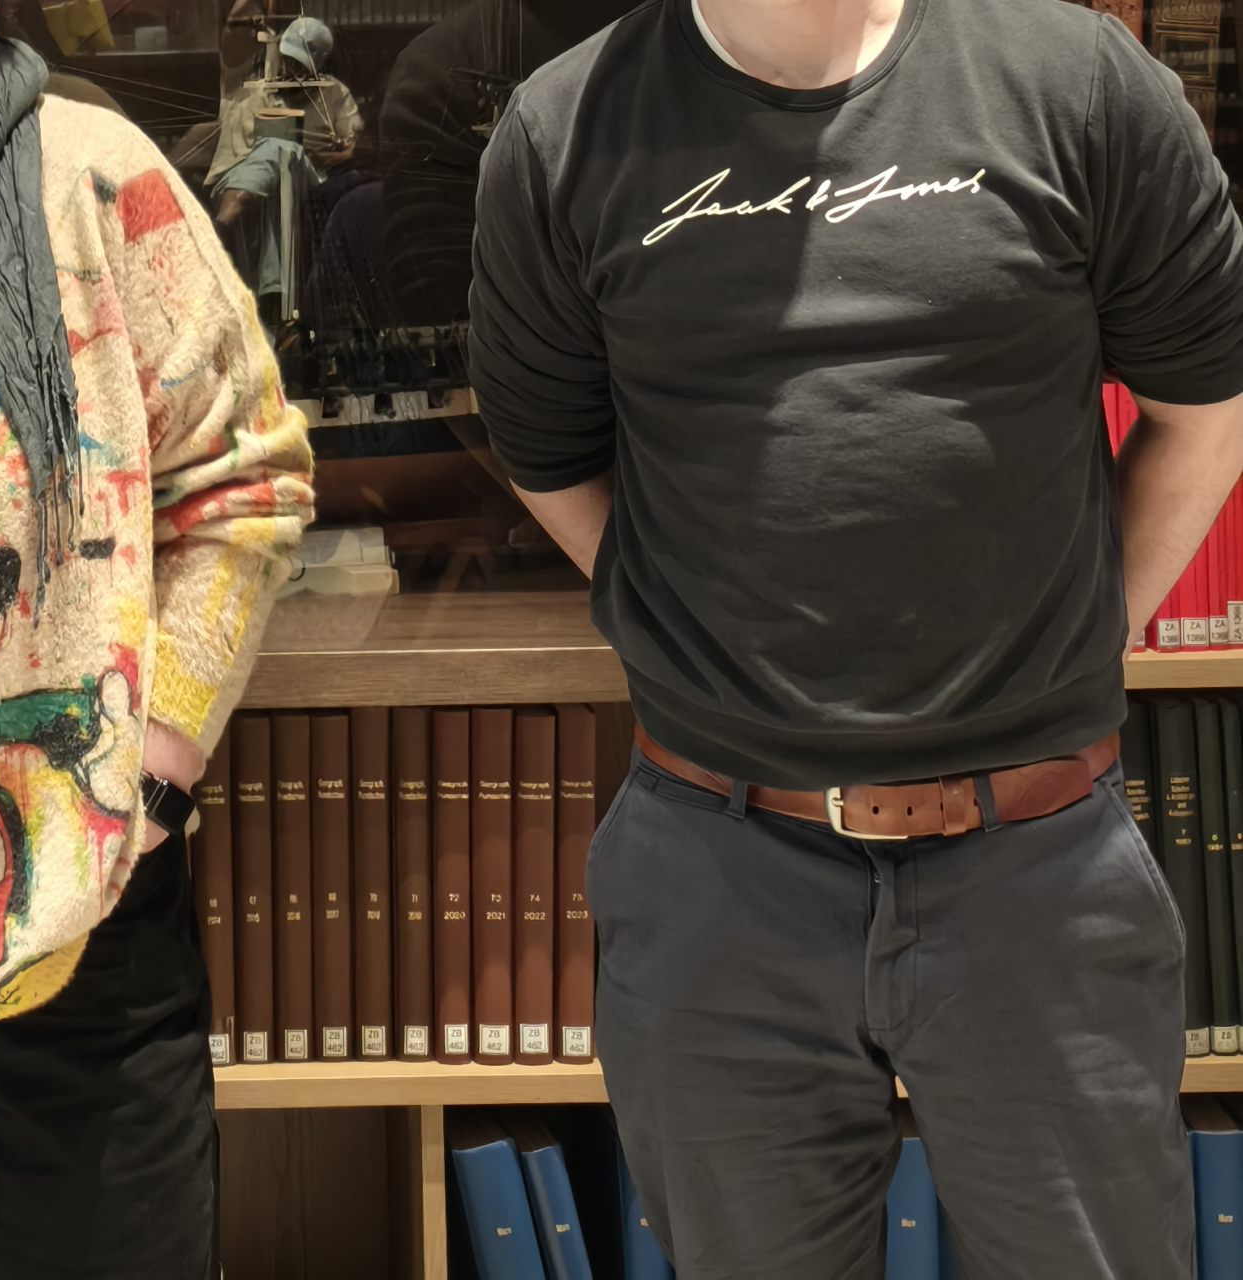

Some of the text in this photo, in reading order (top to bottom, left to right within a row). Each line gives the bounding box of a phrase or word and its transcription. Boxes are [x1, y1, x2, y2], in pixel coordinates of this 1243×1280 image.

[642, 168, 811, 246] Jack
[805, 179, 832, 211] &
[444, 912, 465, 920] 2020
[486, 912, 505, 920] 2021
[524, 912, 545, 920] 2022
[566, 910, 588, 919] 2023
[328, 1032, 340, 1040] ZB
[410, 1030, 422, 1038] ZB
[451, 1029, 462, 1037] ZB
[488, 1030, 500, 1038] ZB
[528, 1028, 540, 1037] ZB
[571, 1031, 582, 1040] ZB
[211, 1039, 222, 1047] ZB
[249, 1036, 261, 1044] ZB
[327, 1044, 342, 1052] 462
[408, 1043, 424, 1051] 462
[486, 1043, 501, 1051] 462
[527, 1041, 542, 1049] 462
